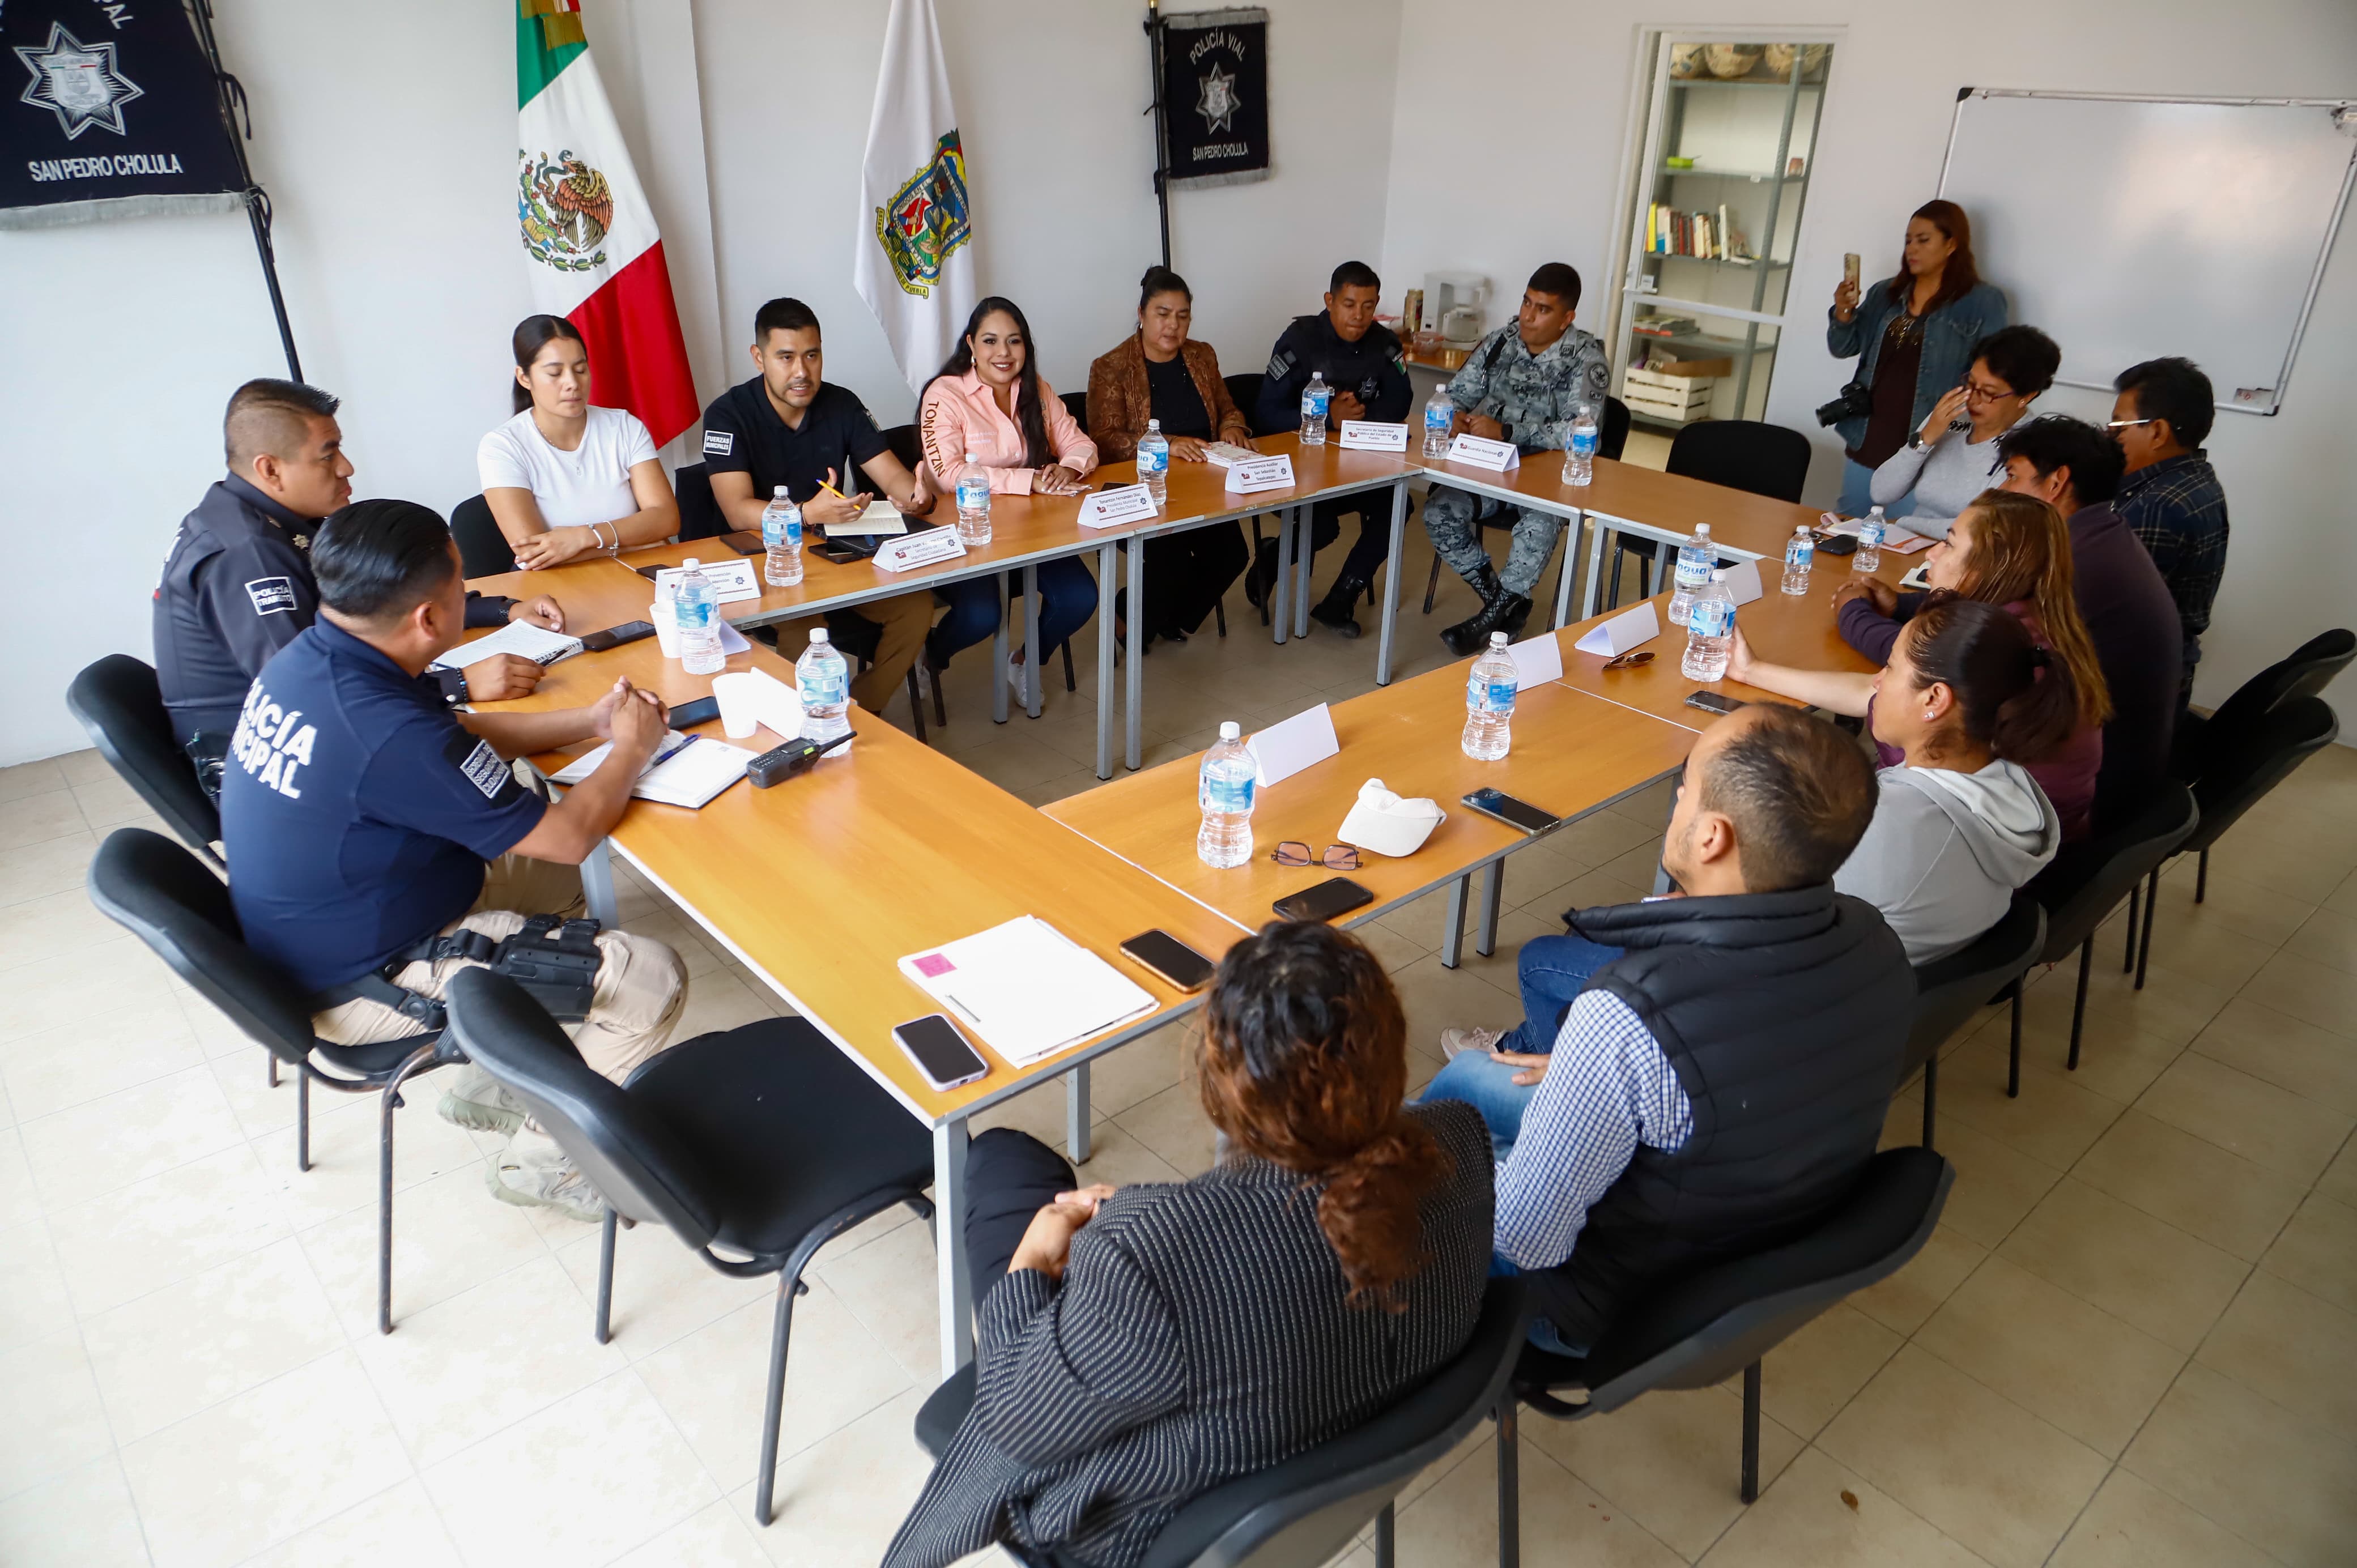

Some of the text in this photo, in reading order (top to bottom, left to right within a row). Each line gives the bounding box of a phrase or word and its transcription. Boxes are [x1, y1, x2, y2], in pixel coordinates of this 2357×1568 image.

[1190, 27, 1246, 66] POLICÍA VIAL
[1193, 142, 1249, 161] SAN PEDRO CHOLULA
[28, 154, 184, 182] SAN PEDRO CHOLULA
[905, 284, 926, 294] PUEBLA
[706, 442, 729, 450] MUNICIPALES
[707, 436, 730, 444] FUERZAS
[922, 401, 946, 478] TONANTZIN
[911, 551, 928, 560] Seguridad
[253, 585, 289, 599] POLICÍA
